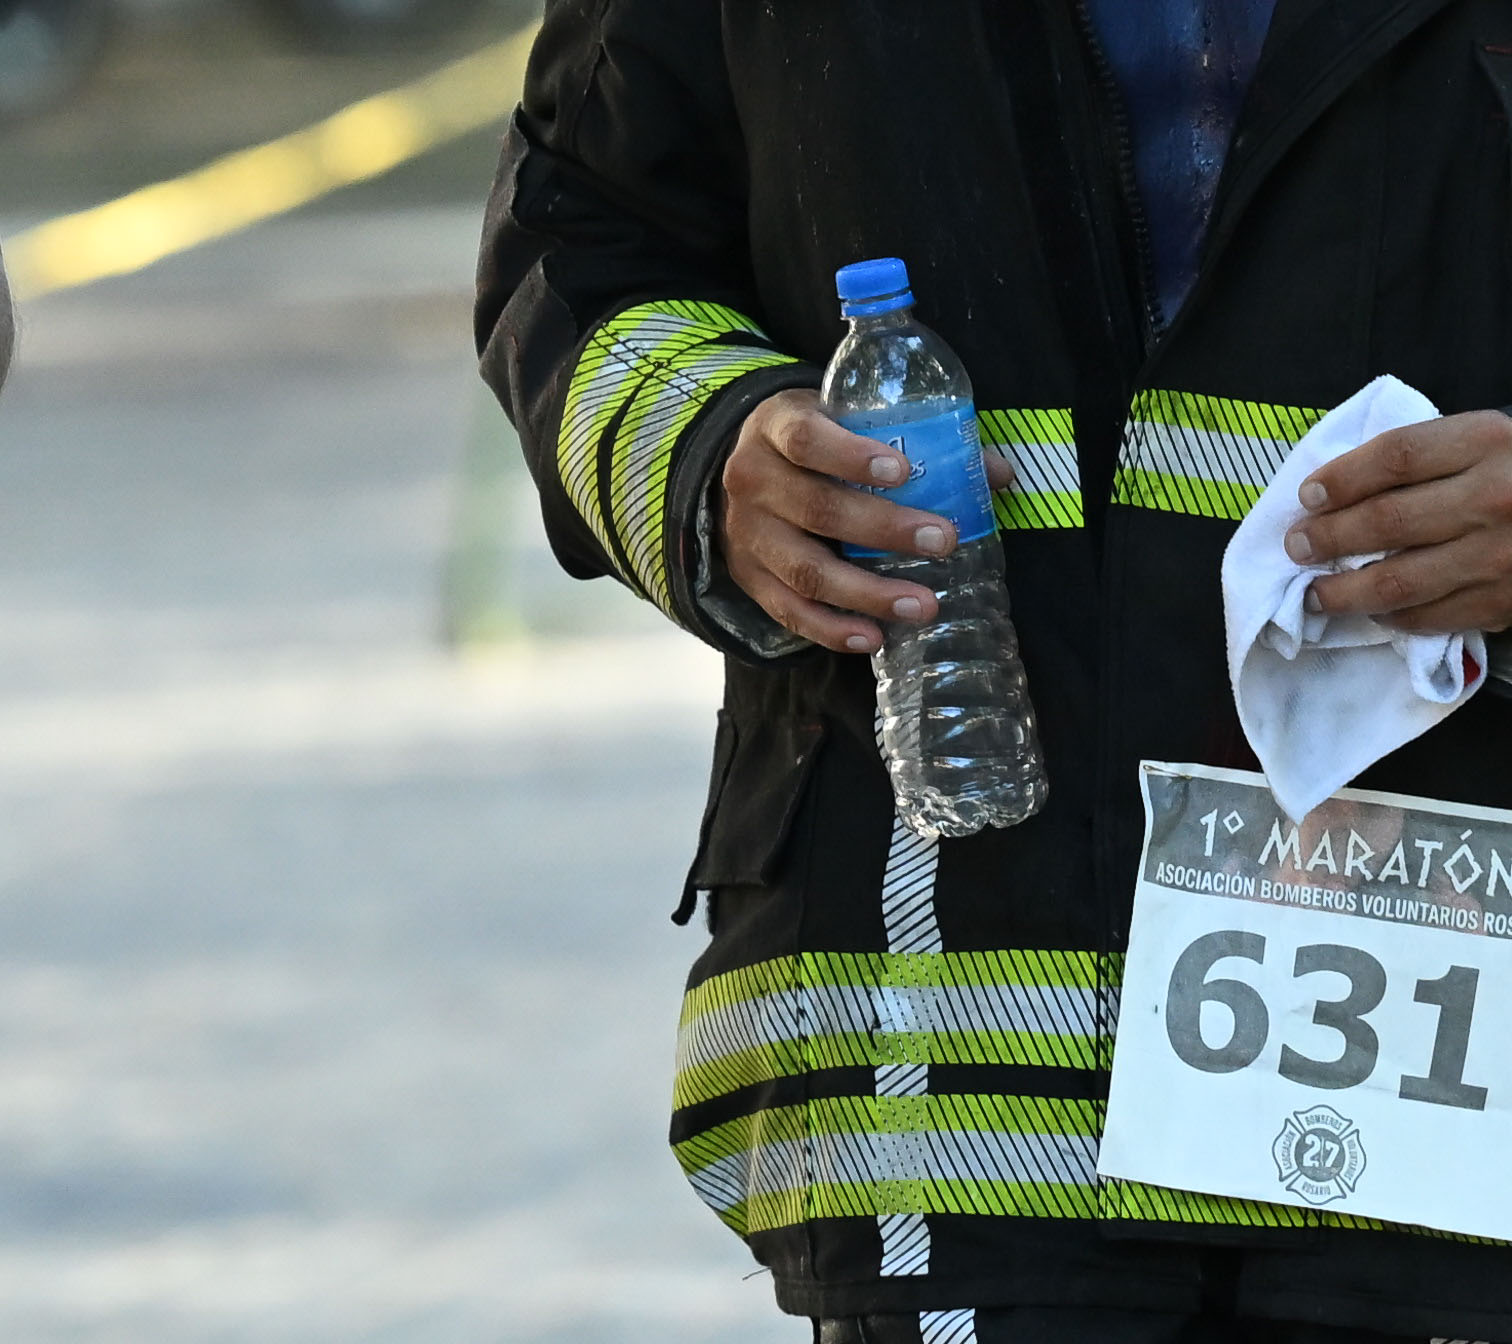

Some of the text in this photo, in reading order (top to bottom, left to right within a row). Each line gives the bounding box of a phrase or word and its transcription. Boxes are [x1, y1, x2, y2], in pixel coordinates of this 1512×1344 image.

[1155, 861, 1256, 897] ASOCIACIÓN
[1260, 879, 1357, 912] BOMBEROS
[1362, 893, 1479, 930] VOLUNTARIOS
[1165, 929, 1489, 1112] 631
[1302, 1133, 1340, 1168] 27
